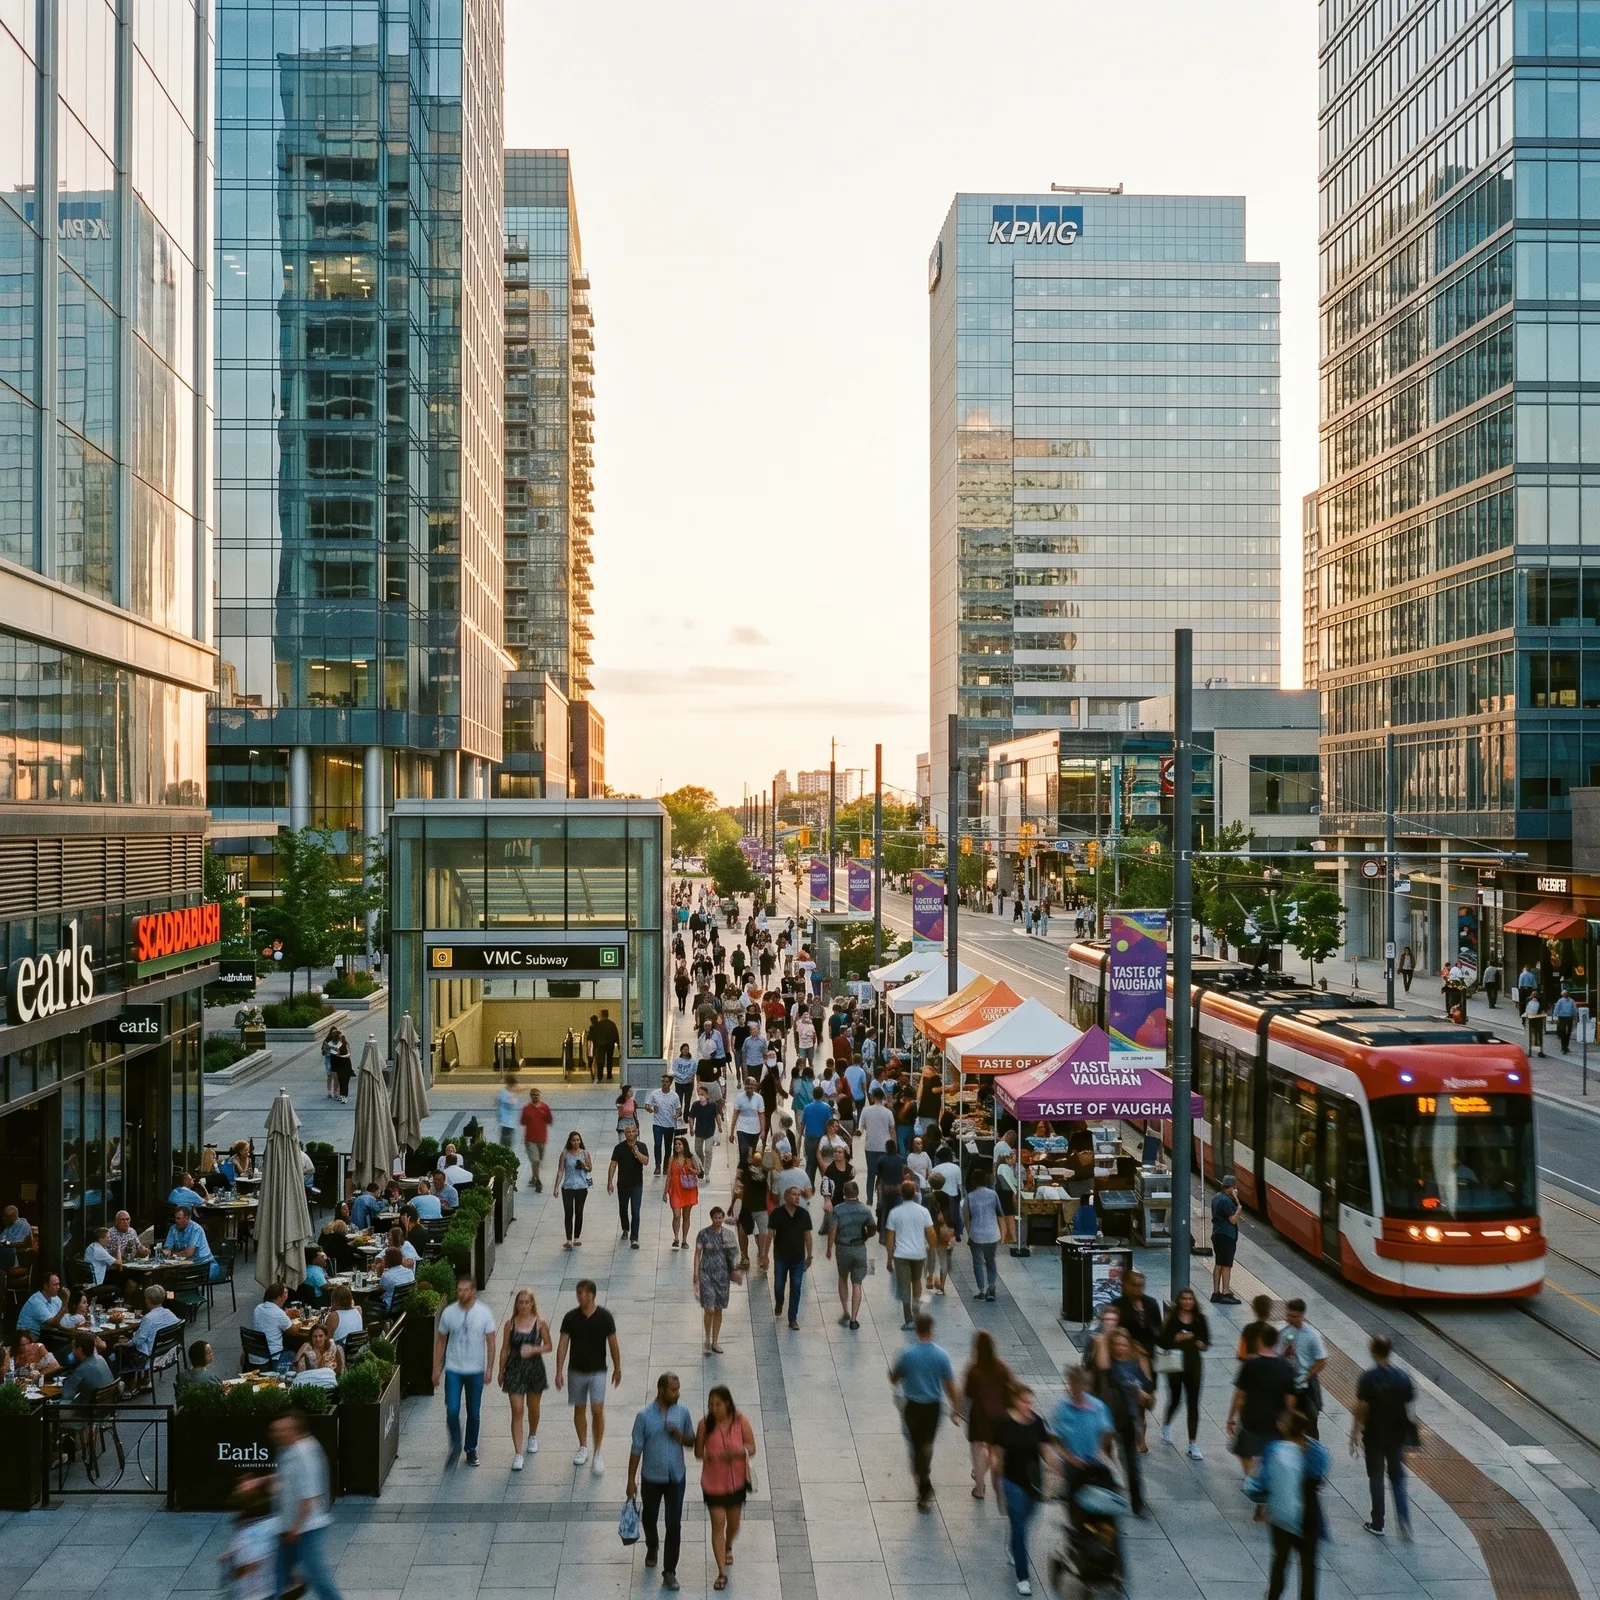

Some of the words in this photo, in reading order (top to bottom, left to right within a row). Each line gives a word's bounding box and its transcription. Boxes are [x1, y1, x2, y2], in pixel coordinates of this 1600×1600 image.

[988, 221, 1078, 244] KPMG
[138, 903, 220, 962] SCADDABUSH
[483, 951, 522, 965] VMC
[526, 954, 569, 967] Subway
[17, 918, 94, 1022] earls
[1113, 966, 1146, 978] TASTE
[1147, 966, 1162, 978] OF
[1111, 979, 1163, 990] VAUGHAN
[119, 1017, 159, 1033] earls
[978, 1059, 1013, 1069] TASTE
[1016, 1059, 1032, 1069] OF
[1070, 1073, 1142, 1086] VAUGHAN
[1038, 1103, 1083, 1115] TASTE
[1087, 1103, 1107, 1115] OF
[1112, 1103, 1173, 1115] VAUGHA
[217, 1442, 269, 1461] Earls
